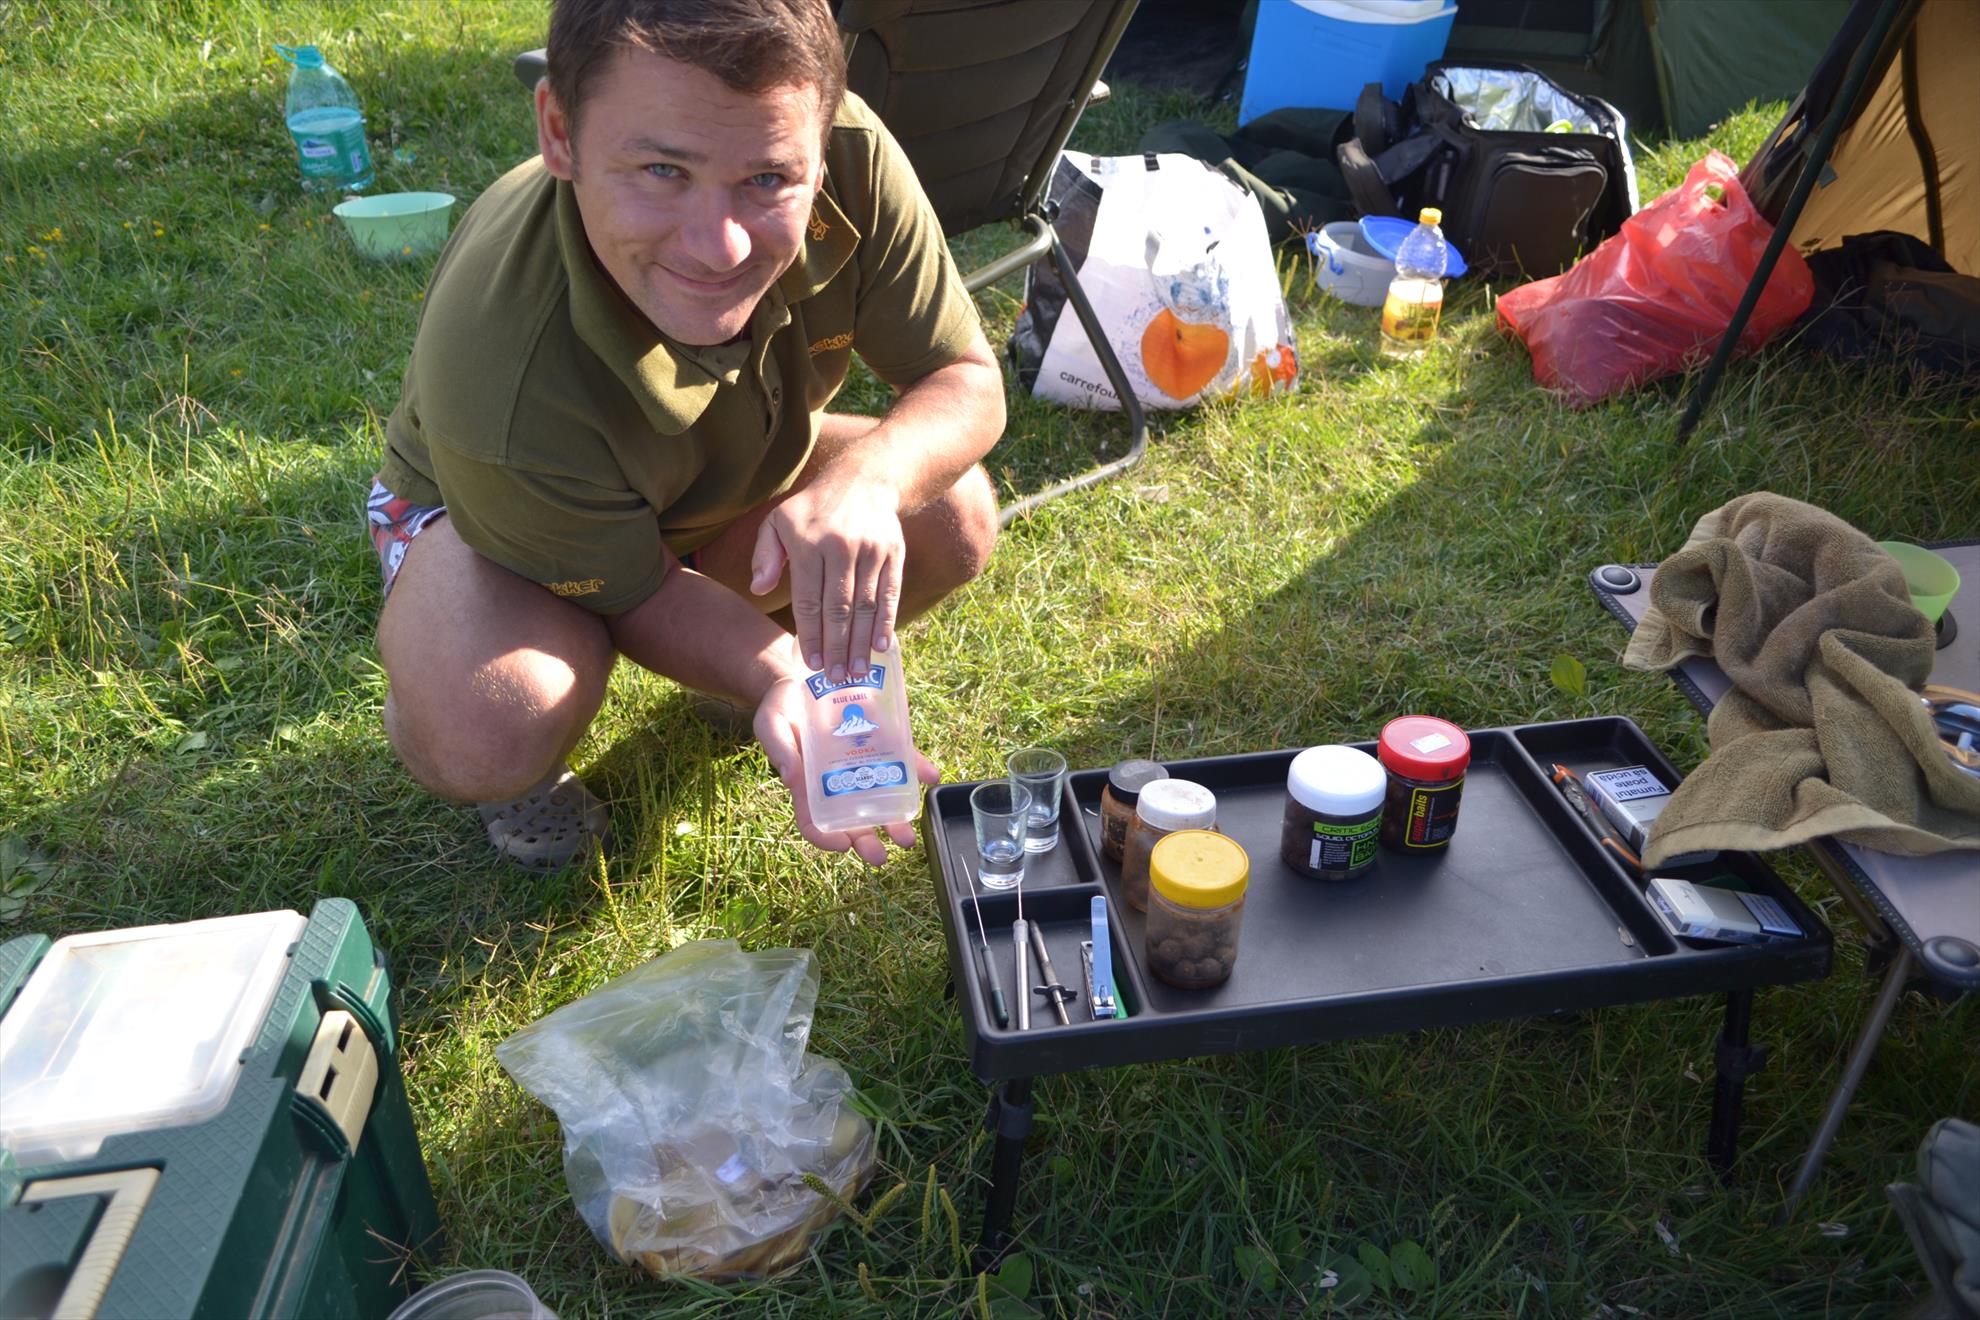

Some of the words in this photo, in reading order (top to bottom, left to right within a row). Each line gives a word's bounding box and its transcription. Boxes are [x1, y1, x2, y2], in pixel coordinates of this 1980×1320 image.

[1060, 371, 1119, 399] carrefou
[832, 695, 848, 704] BLUE
[849, 692, 868, 702] LABEL
[845, 746, 876, 756] VODKA
[1614, 777, 1649, 788] poate
[1615, 785, 1665, 799] Fumatul
